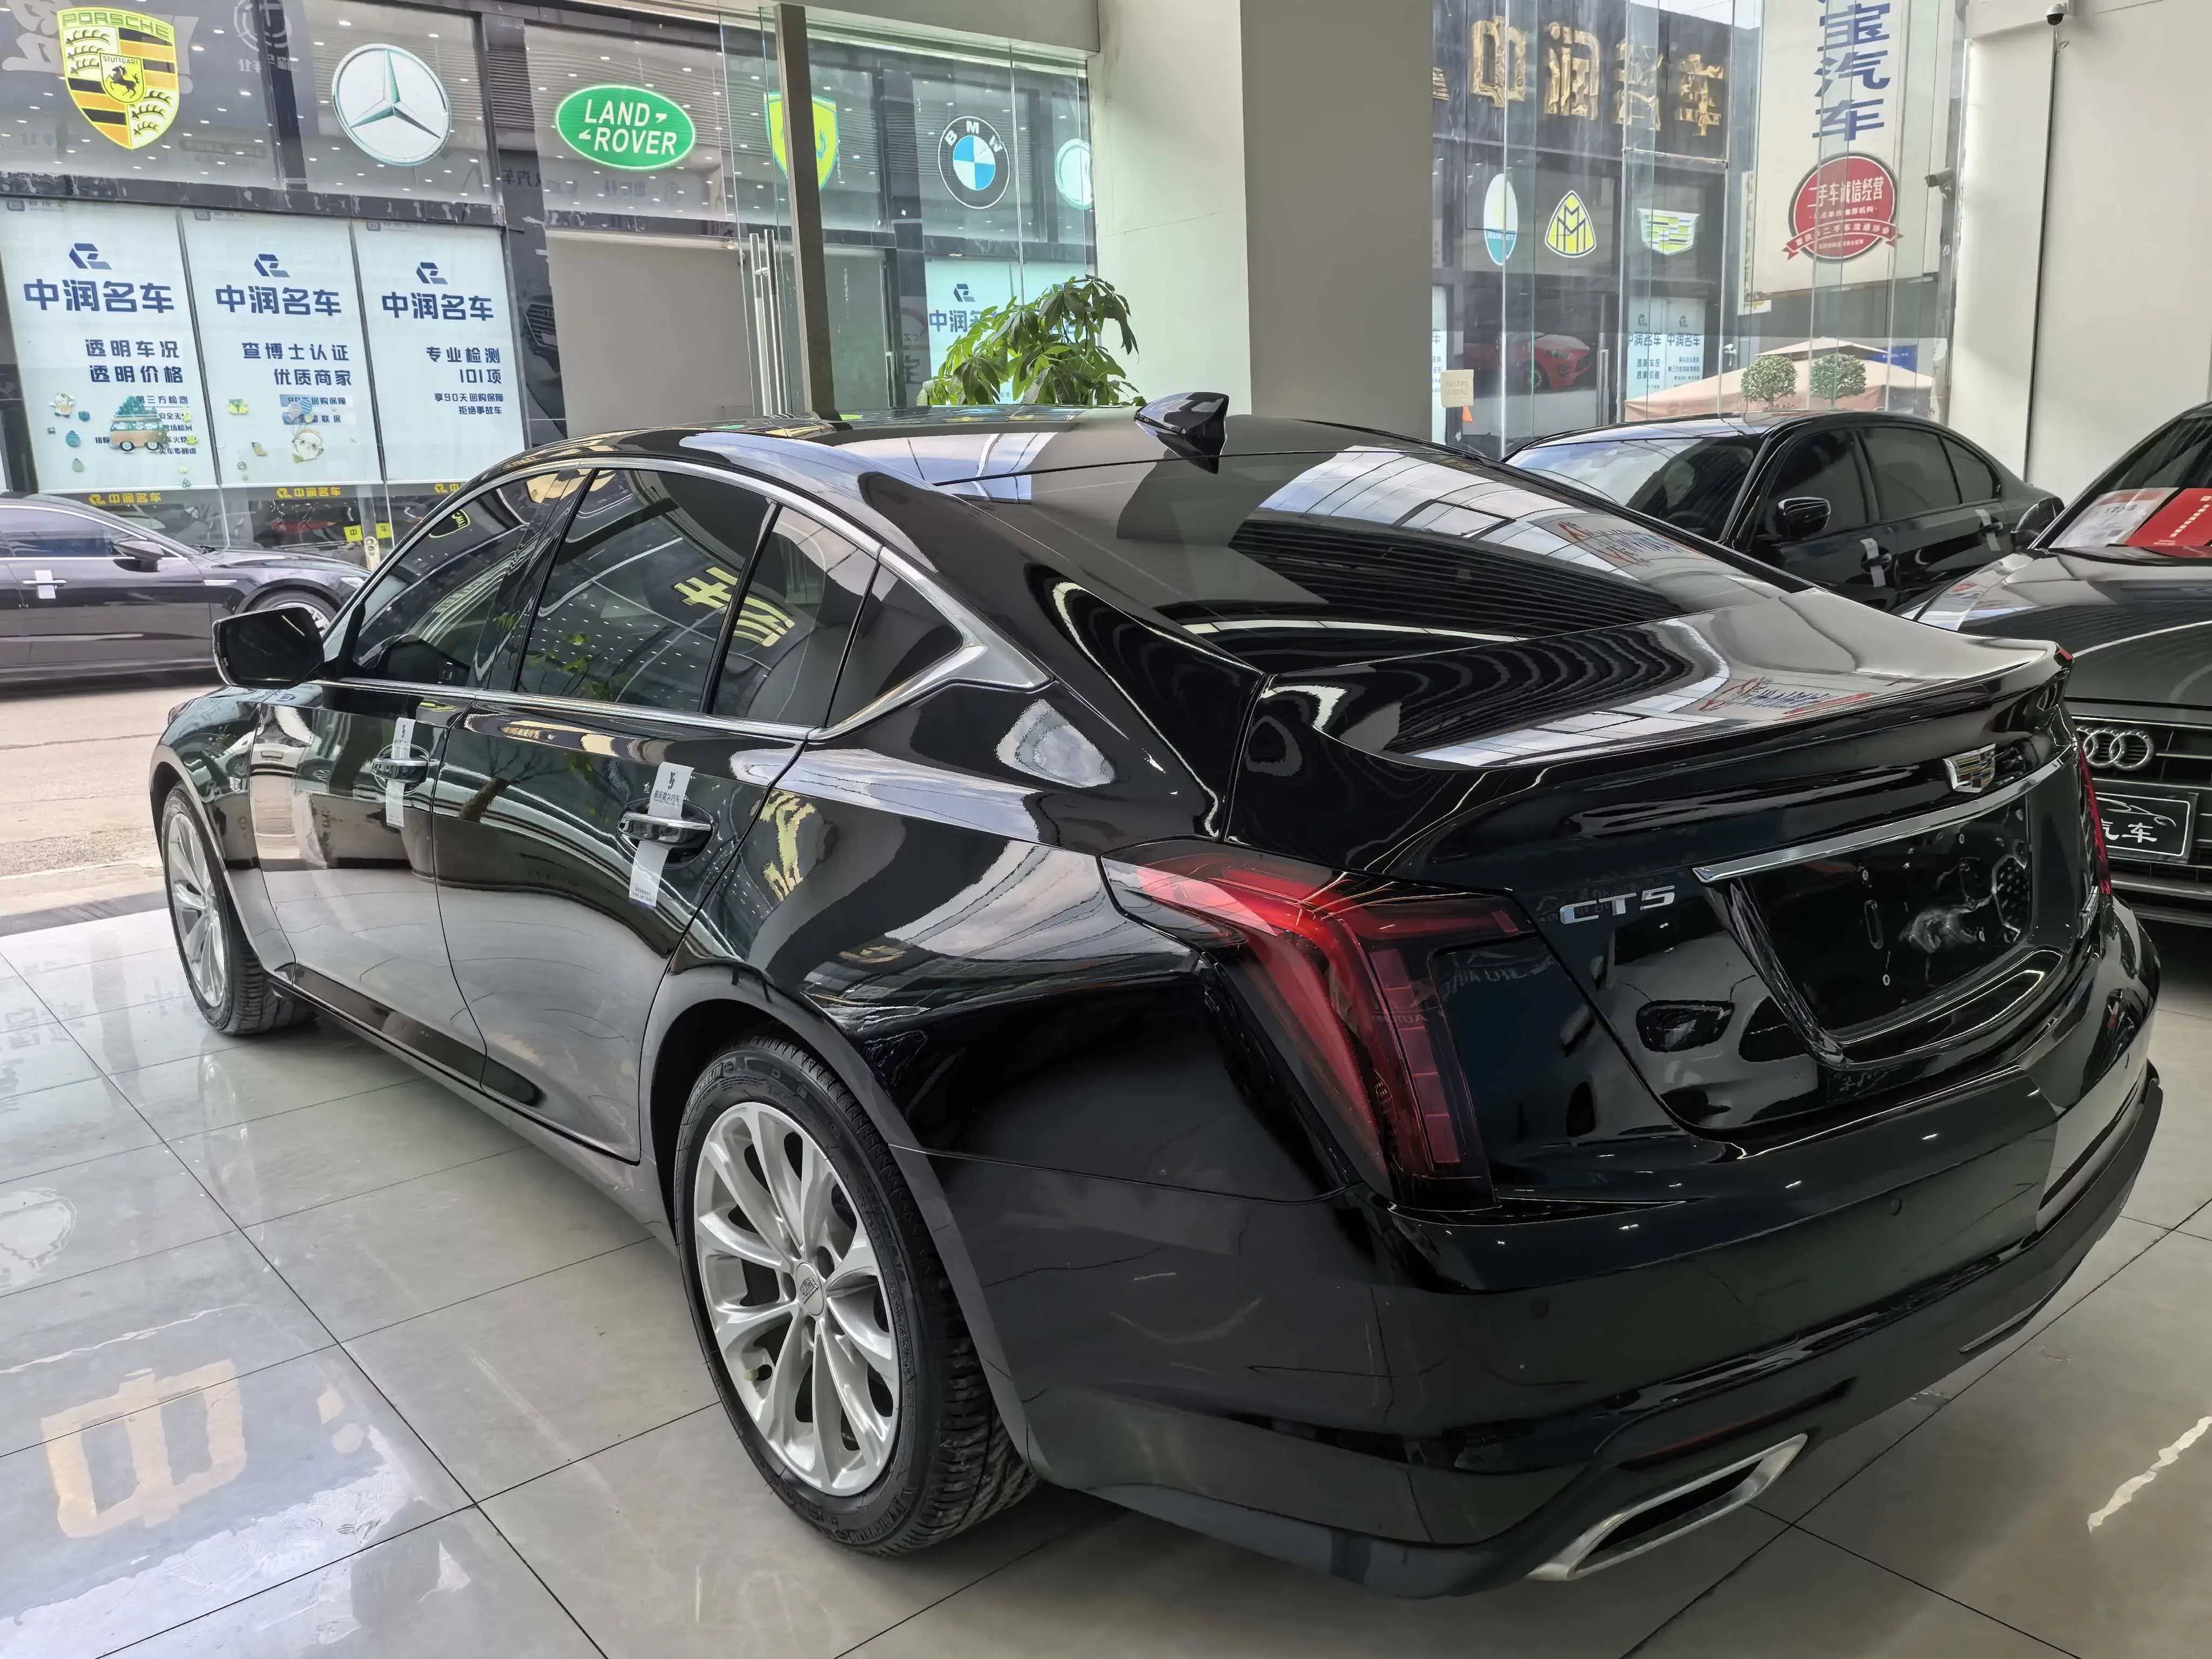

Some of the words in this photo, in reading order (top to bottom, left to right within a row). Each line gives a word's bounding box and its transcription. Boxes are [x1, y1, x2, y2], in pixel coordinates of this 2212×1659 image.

[62, 11, 171, 39] PORSCHE
[103, 55, 139, 66] STUTTGART
[584, 99, 650, 127] LAND
[594, 127, 678, 156] ROVER
[945, 120, 1004, 153] BMW
[1807, 176, 1884, 207] 二手车诚信经营
[24, 278, 174, 313] 中润名车
[215, 284, 341, 316] 中润名车
[382, 292, 494, 321] 中润名车
[85, 339, 179, 358] 透明车况
[242, 342, 350, 361] 查博士认证
[426, 346, 500, 363] 专业检测
[89, 365, 183, 383] 透明价格
[274, 368, 352, 386] 优质商家
[460, 369, 501, 384] 101项
[459, 406, 502, 415] 拒绝事故车
[1560, 885, 1675, 924] CT5
